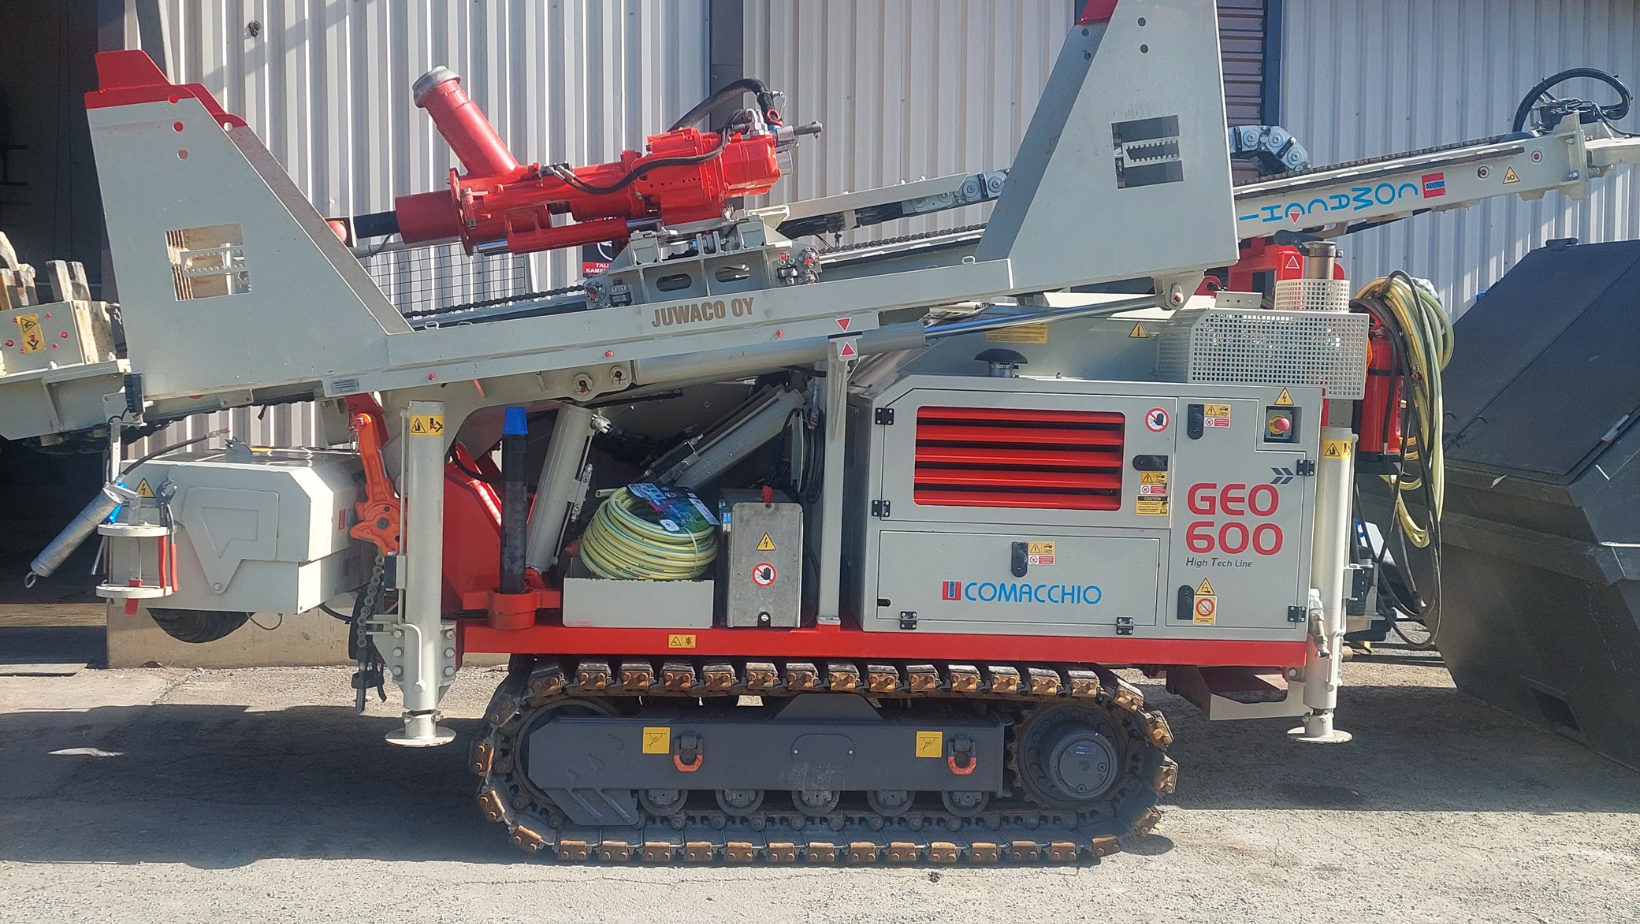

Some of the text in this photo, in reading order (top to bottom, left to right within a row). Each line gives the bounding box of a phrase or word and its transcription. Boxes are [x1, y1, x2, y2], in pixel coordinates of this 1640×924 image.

[651, 296, 754, 328] JUWACO OY
[1187, 482, 1279, 517] GEO
[1185, 520, 1284, 556] 600
[1185, 557, 1253, 568] High Tech Line
[964, 582, 1103, 605] COMACCHIO
